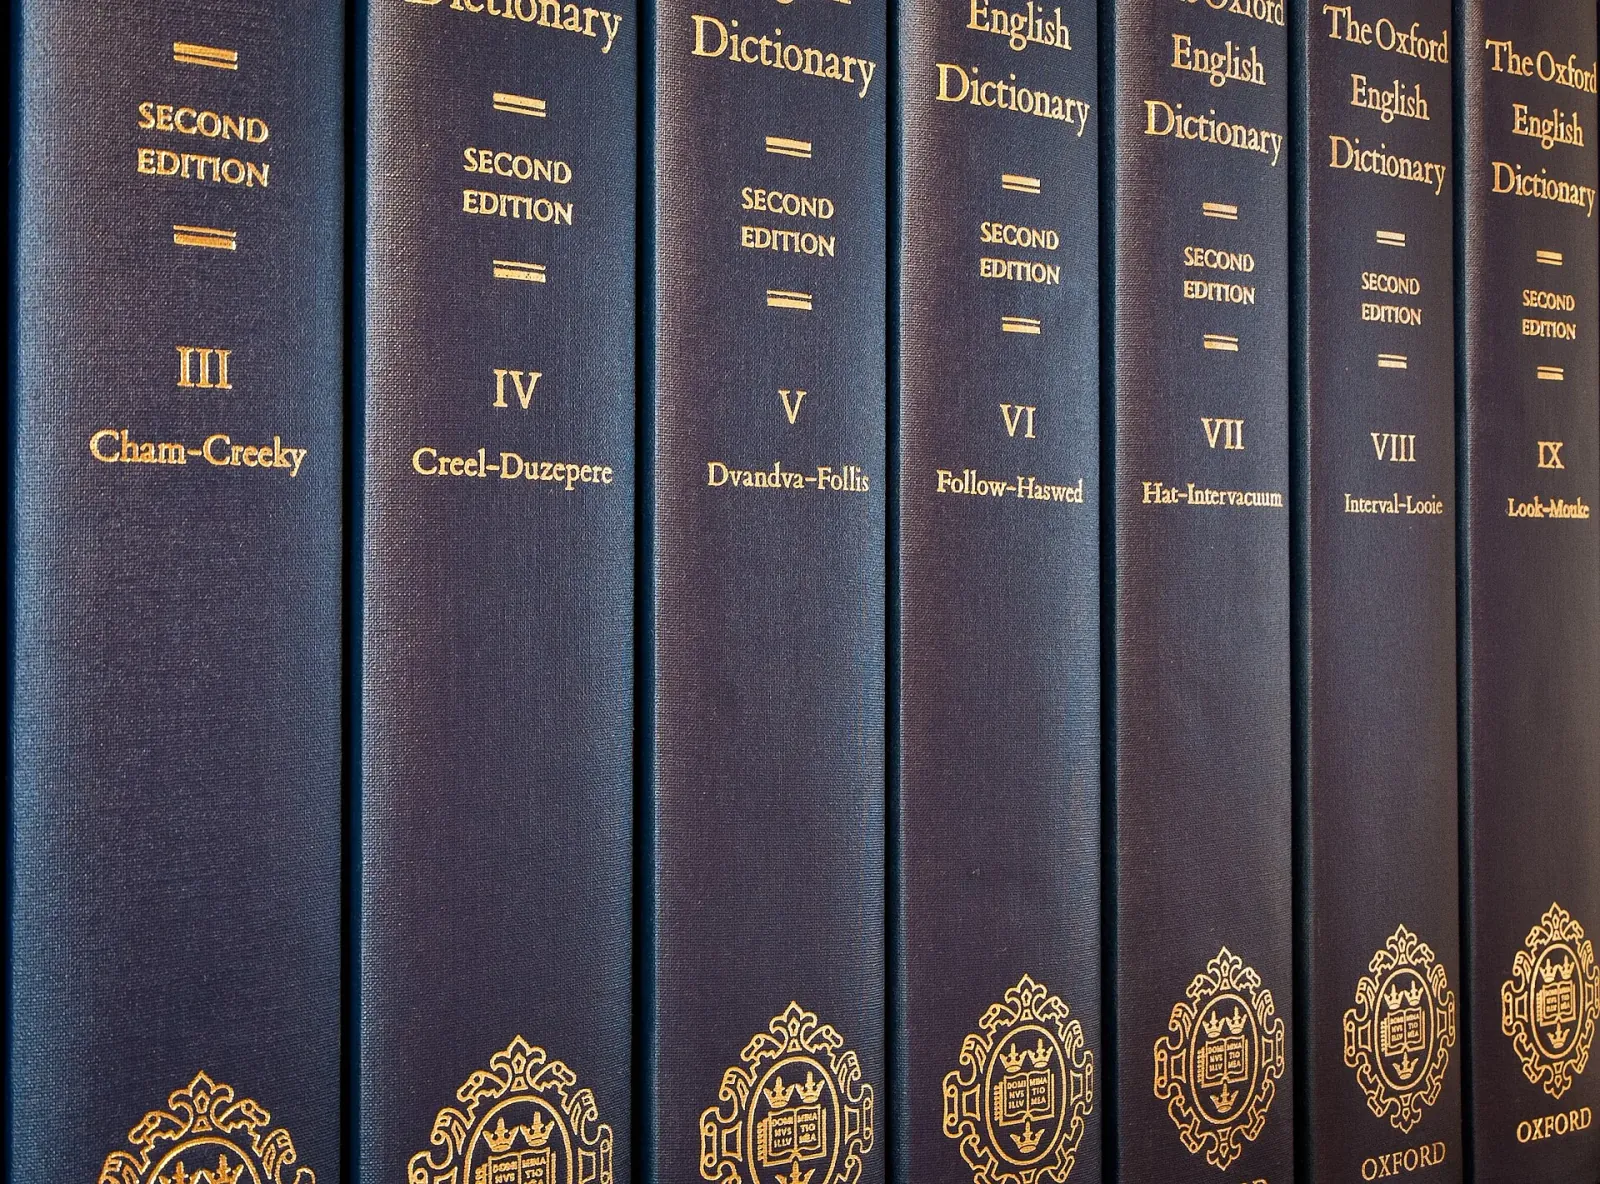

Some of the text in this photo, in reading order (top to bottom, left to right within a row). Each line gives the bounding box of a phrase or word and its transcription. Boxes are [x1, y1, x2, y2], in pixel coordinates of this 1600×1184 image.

[966, 0, 1072, 51] English
[1322, 3, 1449, 64] The Oxford
[691, 14, 876, 99] Dictionary
[1171, 33, 1267, 88] English
[1485, 38, 1598, 94] The Oxford
[935, 62, 1090, 137] Dictionary
[1350, 73, 1431, 124] English
[137, 101, 269, 144] SECOND
[1143, 99, 1283, 166] Dictionary
[1511, 103, 1585, 150] English
[136, 147, 269, 189] EDITION
[463, 146, 572, 185] SECOND
[1328, 134, 1447, 196] Dictionary
[462, 188, 574, 226] EDITION
[741, 186, 835, 220] SECOND
[1491, 161, 1597, 218] Dictionary
[741, 224, 836, 258] EDITION
[980, 221, 1060, 251] SECOND
[979, 256, 1062, 286] EDITION
[1183, 245, 1256, 273] SECOND
[1182, 279, 1256, 306] EDITION
[1361, 271, 1421, 297] SECOND
[1521, 289, 1577, 313] SECOND
[1361, 302, 1422, 327] EDITION
[1521, 318, 1577, 341] EDITION
[176, 345, 233, 390] III
[493, 368, 541, 409] IV
[778, 388, 806, 424] V
[1000, 403, 1037, 438] VI
[1201, 417, 1245, 450] VII
[89, 427, 307, 478] Cham-Creeky
[1371, 432, 1416, 462] VIII
[1537, 440, 1566, 470] IX
[411, 446, 613, 491] Creel-Duzepere
[706, 460, 869, 492] Dvandva-Follis
[936, 468, 1084, 503] Follow-Haswed
[1141, 480, 1284, 508] Hat-Intervacuum
[1344, 493, 1444, 516] Interval-Looie
[1007, 1080, 1027, 1090] DOMI
[1009, 1090, 1025, 1099] NVS
[1032, 1086, 1046, 1096] TIO
[1008, 1100, 1025, 1109] ILLV
[1516, 1106, 1592, 1144] OXFORD
[1361, 1141, 1446, 1181] OXFORD
